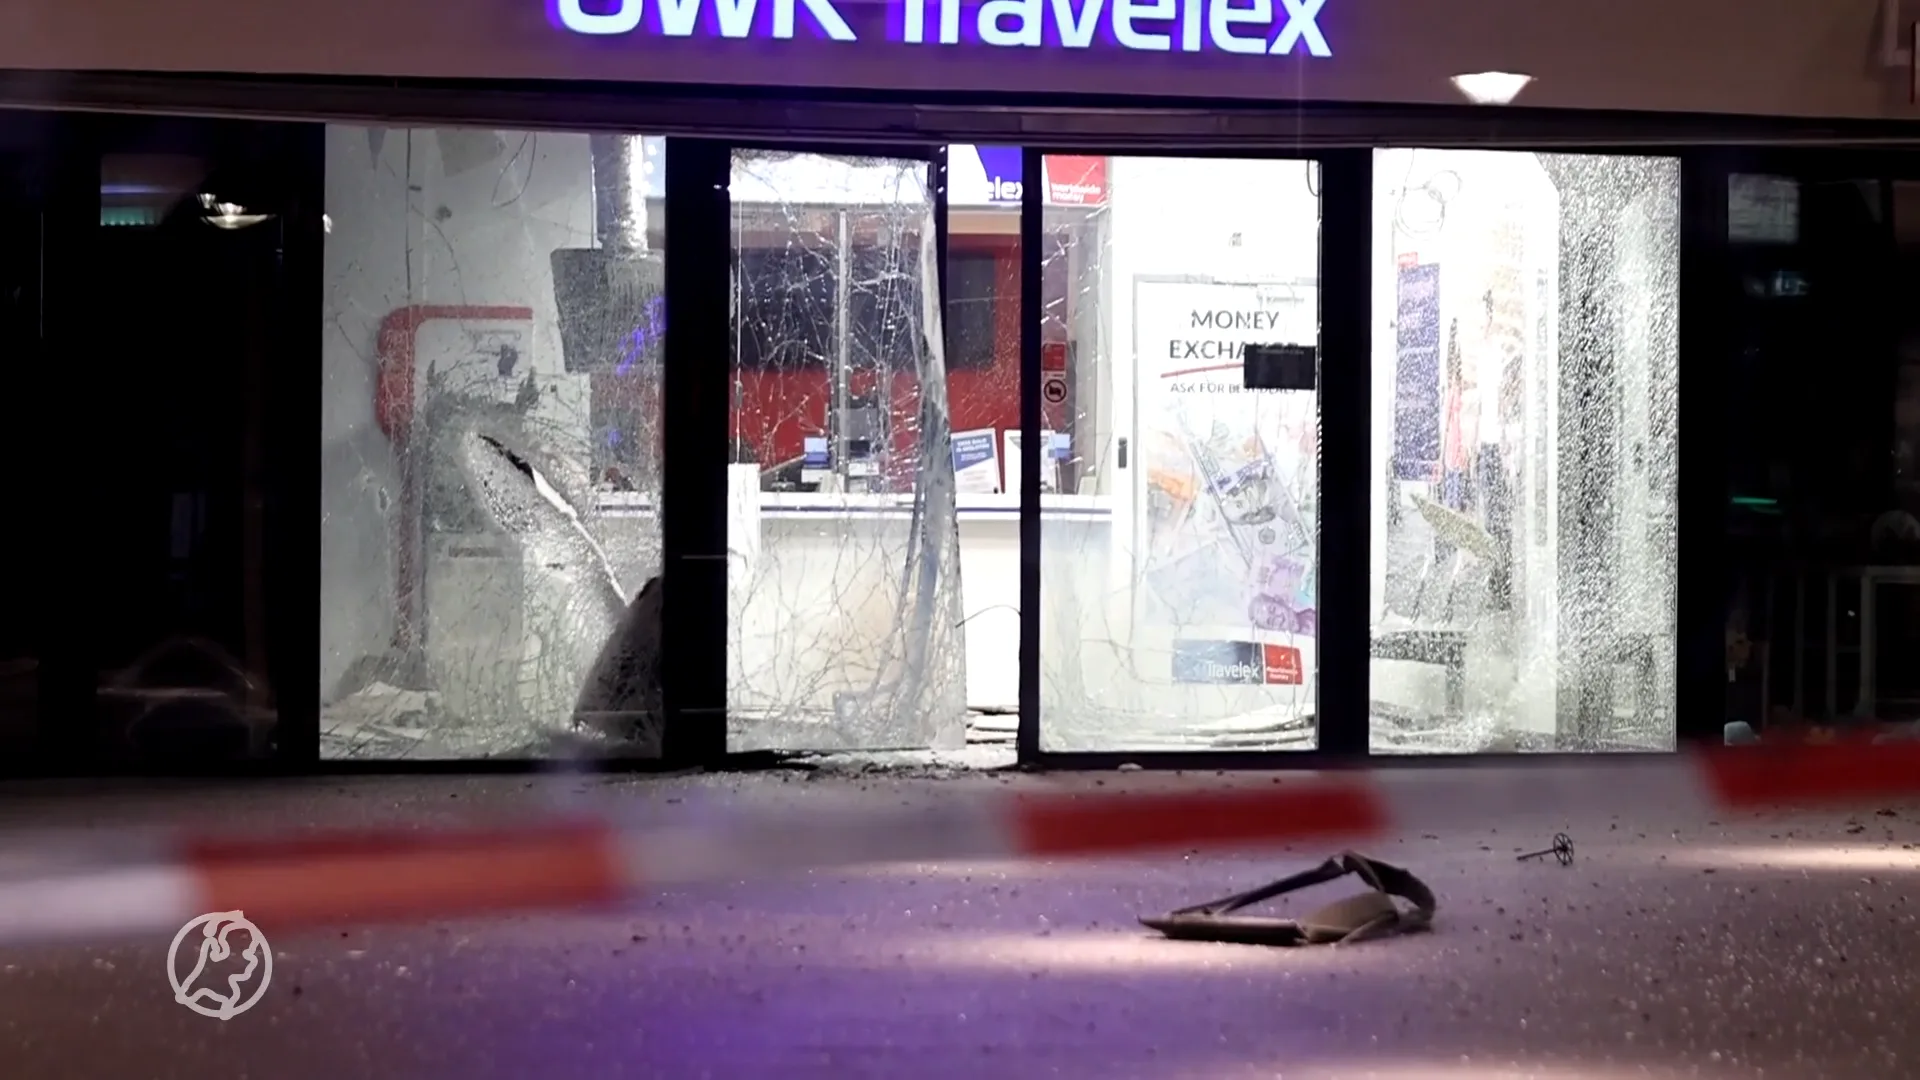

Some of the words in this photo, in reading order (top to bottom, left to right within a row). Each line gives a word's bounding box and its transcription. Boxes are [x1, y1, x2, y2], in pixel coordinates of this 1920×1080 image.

[1191, 309, 1279, 330] MONEY
[1170, 382, 1195, 393] ASK
[1200, 382, 1224, 393] FOR
[1205, 660, 1260, 679] Travelex
